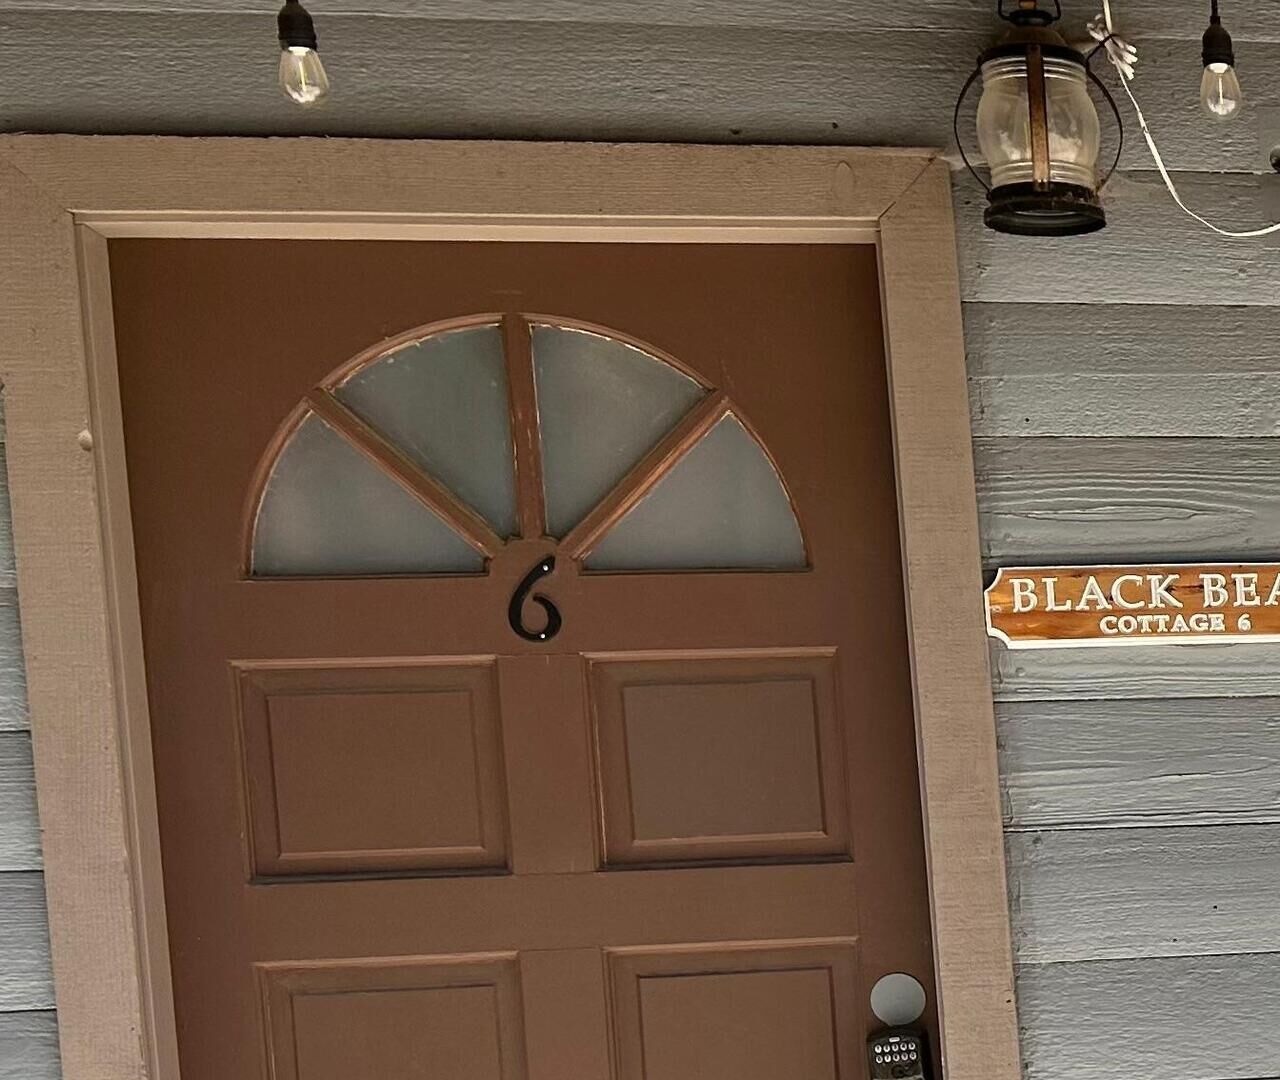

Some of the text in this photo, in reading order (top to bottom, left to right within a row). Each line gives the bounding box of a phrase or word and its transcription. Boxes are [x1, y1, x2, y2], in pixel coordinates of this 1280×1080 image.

[508, 554, 561, 643] 6
[1009, 574, 1184, 613] BLACK
[1100, 613, 1252, 634] COTTAGE 6
